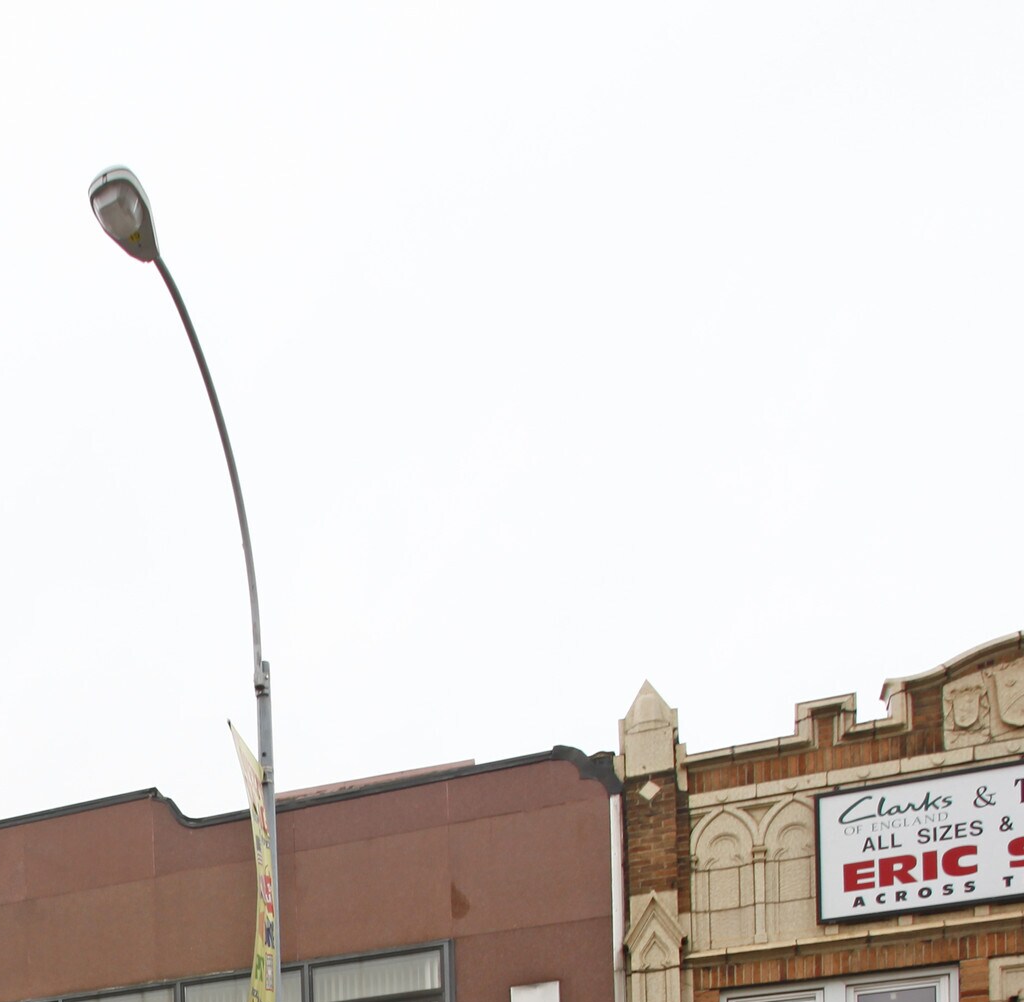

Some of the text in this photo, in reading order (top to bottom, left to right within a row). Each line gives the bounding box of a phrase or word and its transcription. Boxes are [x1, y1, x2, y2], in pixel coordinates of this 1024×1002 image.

[838, 791, 953, 825] Clarks
[973, 785, 997, 808] &
[843, 811, 949, 839] OF ENGLAND
[862, 815, 1013, 853] ALL SIZES &
[842, 845, 978, 893] ERIC
[852, 880, 976, 908] ACROSS
